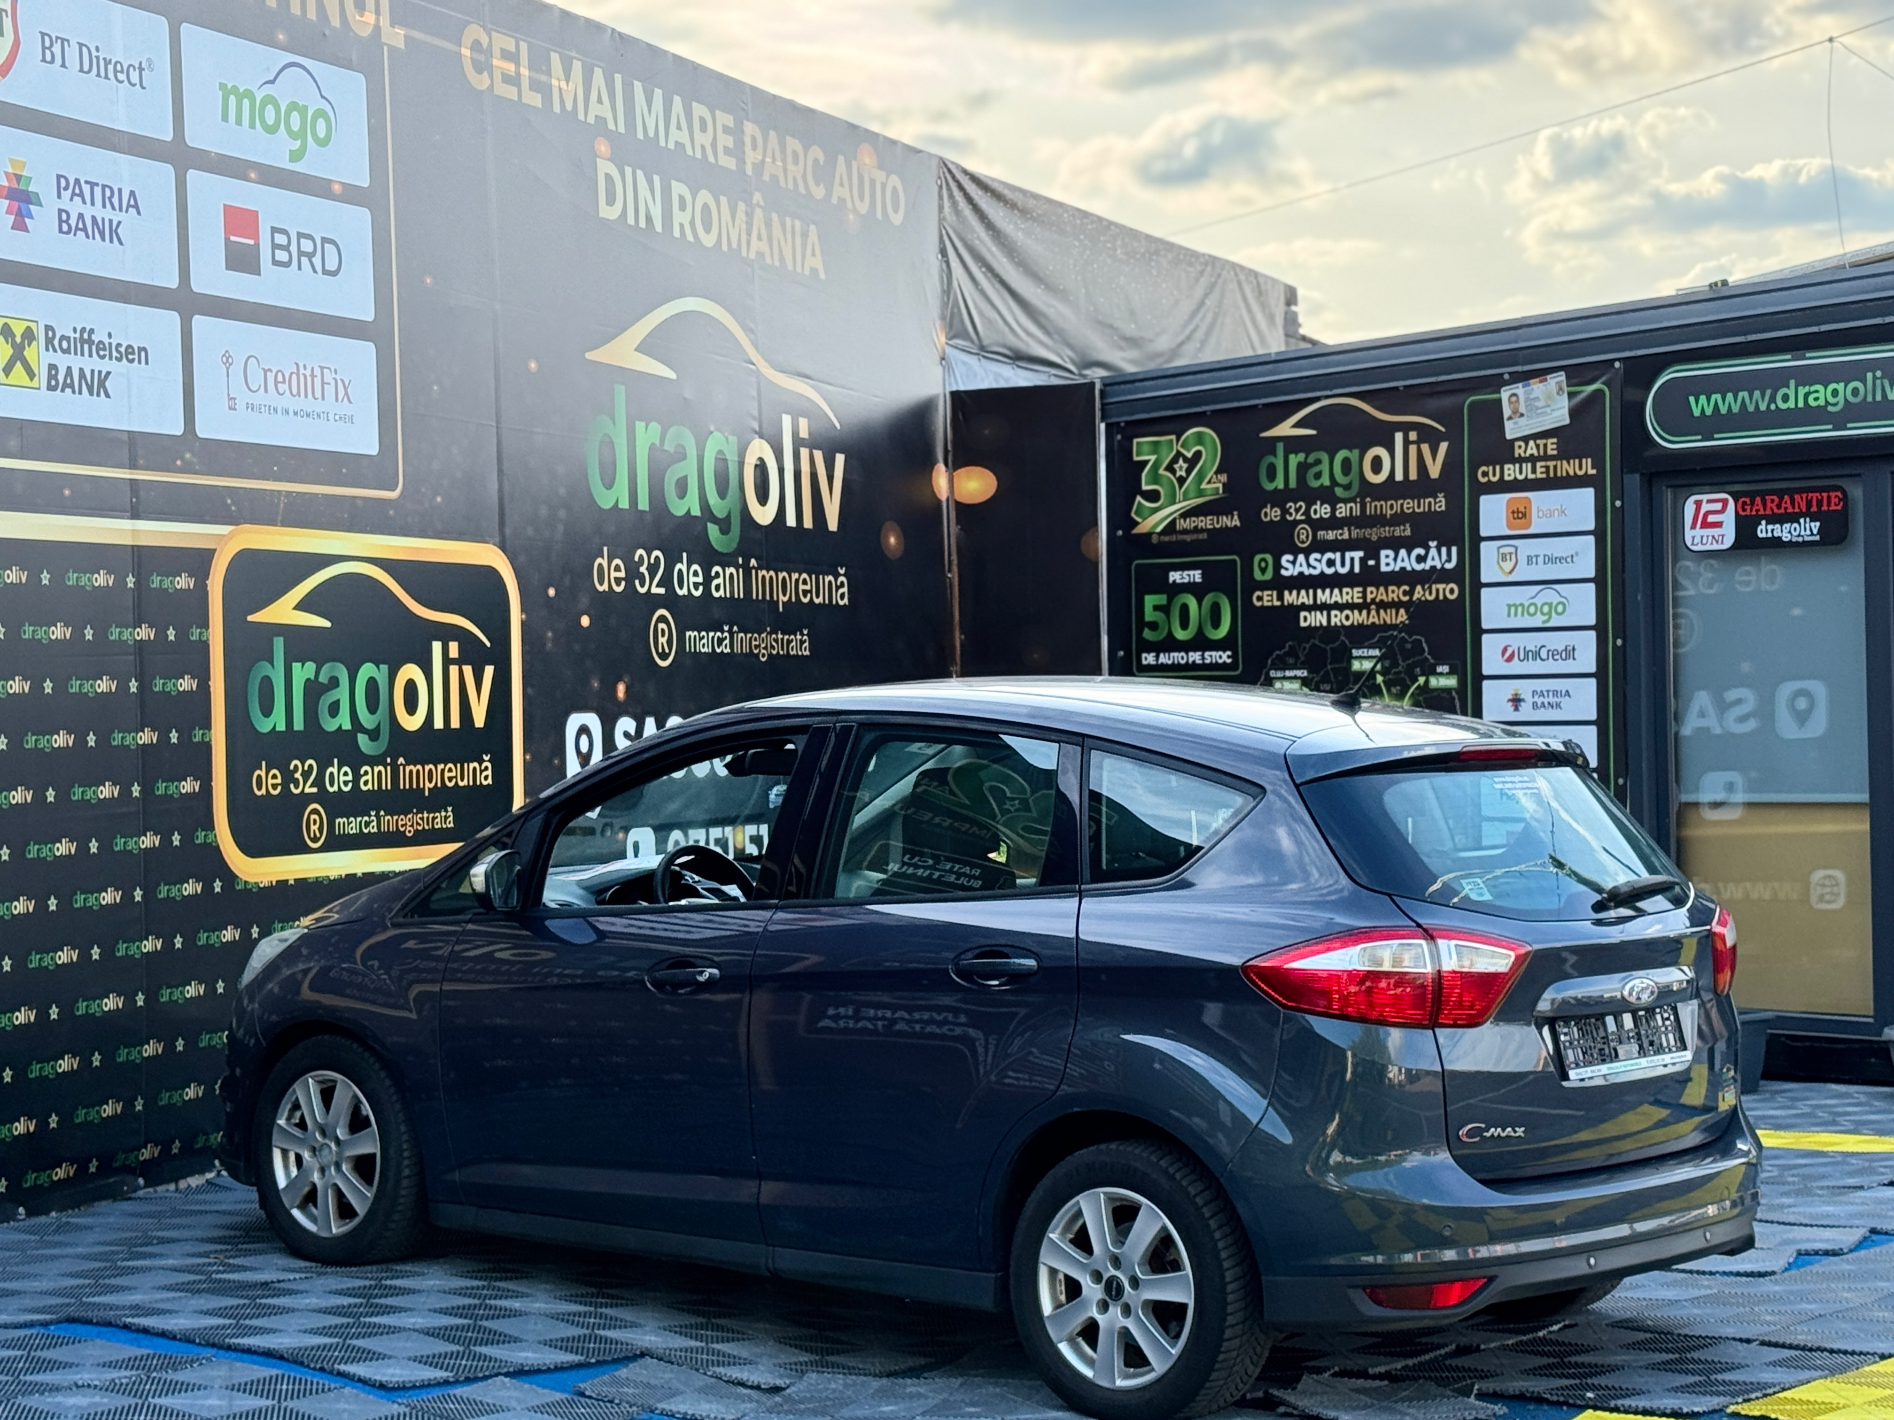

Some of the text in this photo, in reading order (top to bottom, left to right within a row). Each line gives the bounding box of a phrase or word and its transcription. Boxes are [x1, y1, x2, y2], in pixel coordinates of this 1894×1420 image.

[39, 30, 70, 70] BT
[218, 81, 334, 163] mogo
[460, 23, 542, 109] CEL
[550, 51, 626, 134] MAI
[633, 80, 737, 172] MARE
[743, 120, 826, 200] PARC
[832, 153, 905, 226] AUTO
[55, 173, 142, 217] PATRIA
[57, 208, 125, 247] BANK
[596, 157, 826, 280] DIN ROMÂNIA
[270, 225, 343, 279] BRD
[44, 324, 149, 367] Raiffeisen
[46, 363, 112, 400] BANK
[242, 354, 354, 405] CreditFix
[246, 402, 278, 416] PRIETEN
[282, 406, 290, 417] IN
[293, 408, 330, 422] MOMENTE
[1514, 438, 1558, 459] RATE
[586, 384, 846, 553] dragoliv
[1131, 426, 1222, 522] 32
[1259, 431, 1449, 498] dragoliv
[1477, 457, 1597, 484] CU BULETINUL
[1261, 493, 1446, 522] de 32 de ani împreună
[1511, 504, 1568, 521] tbi bank
[1690, 491, 1844, 531] 12 GARANTIE
[1317, 526, 1350, 542] marcă
[1351, 523, 1412, 543] înregistrată
[1690, 533, 1726, 547] LUNI
[1757, 517, 1820, 542] dragoliv
[1280, 550, 1364, 578] SASCUT
[1380, 541, 1458, 572] BACĂU
[1501, 552, 1514, 563] BT
[1526, 554, 1541, 566] BT
[65, 569, 114, 591] dragoliv
[150, 572, 195, 592] dragoliv
[593, 547, 849, 612] de 32 de ani împreună
[1169, 570, 1202, 584] PESTE
[1252, 583, 1459, 607] CEL MAI MARE PARC AUTO
[1142, 592, 1232, 642] 500
[1300, 607, 1409, 628] DIN ROMÂNIA
[1506, 600, 1568, 625] mogo
[21, 622, 156, 644] dragoliv dragoliv
[686, 625, 731, 654] marcă
[733, 626, 810, 662] înregistrată
[1142, 650, 1232, 665] DE AUTO PE STOC
[1517, 644, 1577, 663] UniCredit
[68, 676, 117, 697] dragoliv
[152, 674, 198, 696] dragoliv
[247, 636, 495, 756] dragoliv
[1531, 689, 1572, 700] PATRIA
[1532, 700, 1563, 711] BANK
[23, 728, 158, 752] dragoliv dragoliv
[70, 782, 120, 804] dragoliv
[154, 776, 200, 798] dragoliv
[252, 754, 493, 797] de 32 de ani împreună
[335, 809, 378, 836] marcă
[380, 806, 455, 838] înregistrată
[26, 838, 77, 860] dragoliv
[113, 832, 161, 853] dragoliv
[72, 888, 122, 909] dragoliv
[156, 878, 203, 900] dragoliv
[27, 946, 79, 970] dragoliv
[115, 936, 163, 958] dragoliv
[196, 925, 241, 947] dragoliv
[74, 993, 125, 1016] dragoliv
[159, 980, 206, 1003] dragoliv
[28, 1052, 80, 1079] dragoliv
[116, 1038, 164, 1064] dragoliv
[73, 1098, 123, 1125] dragoliv
[158, 1082, 204, 1106] dragoliv
[22, 1162, 77, 1189] dragoliv
